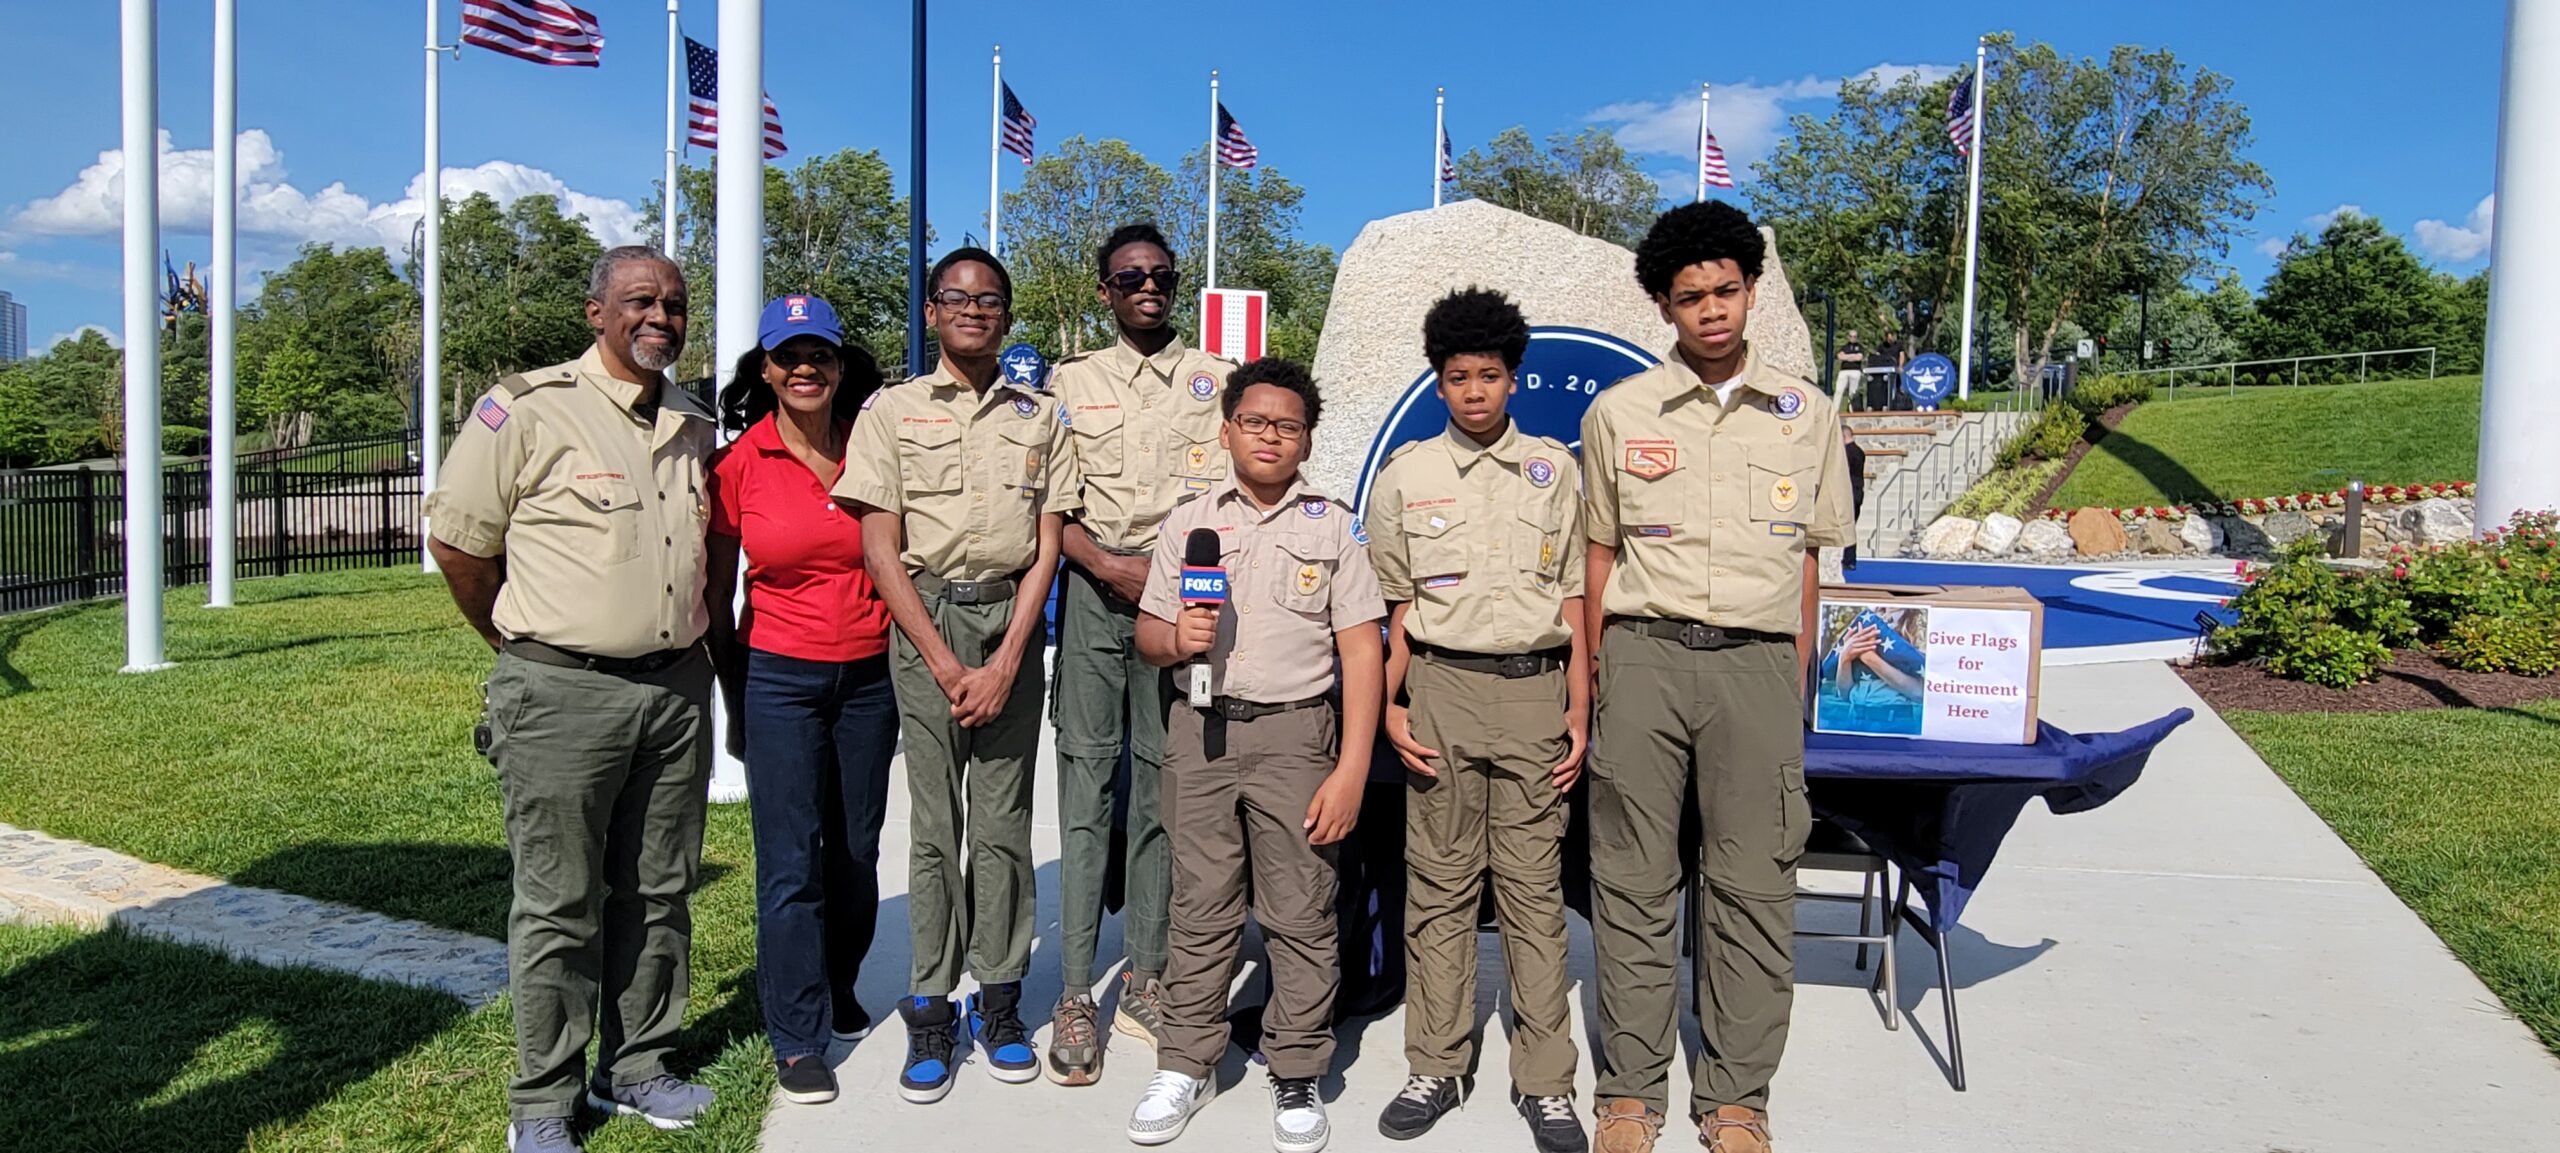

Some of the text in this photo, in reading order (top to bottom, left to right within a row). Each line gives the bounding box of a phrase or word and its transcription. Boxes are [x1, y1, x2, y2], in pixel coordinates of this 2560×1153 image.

[1928, 631, 2018, 652] Give Flags
[1958, 656, 1984, 671] for
[1947, 704, 1990, 719] Here
